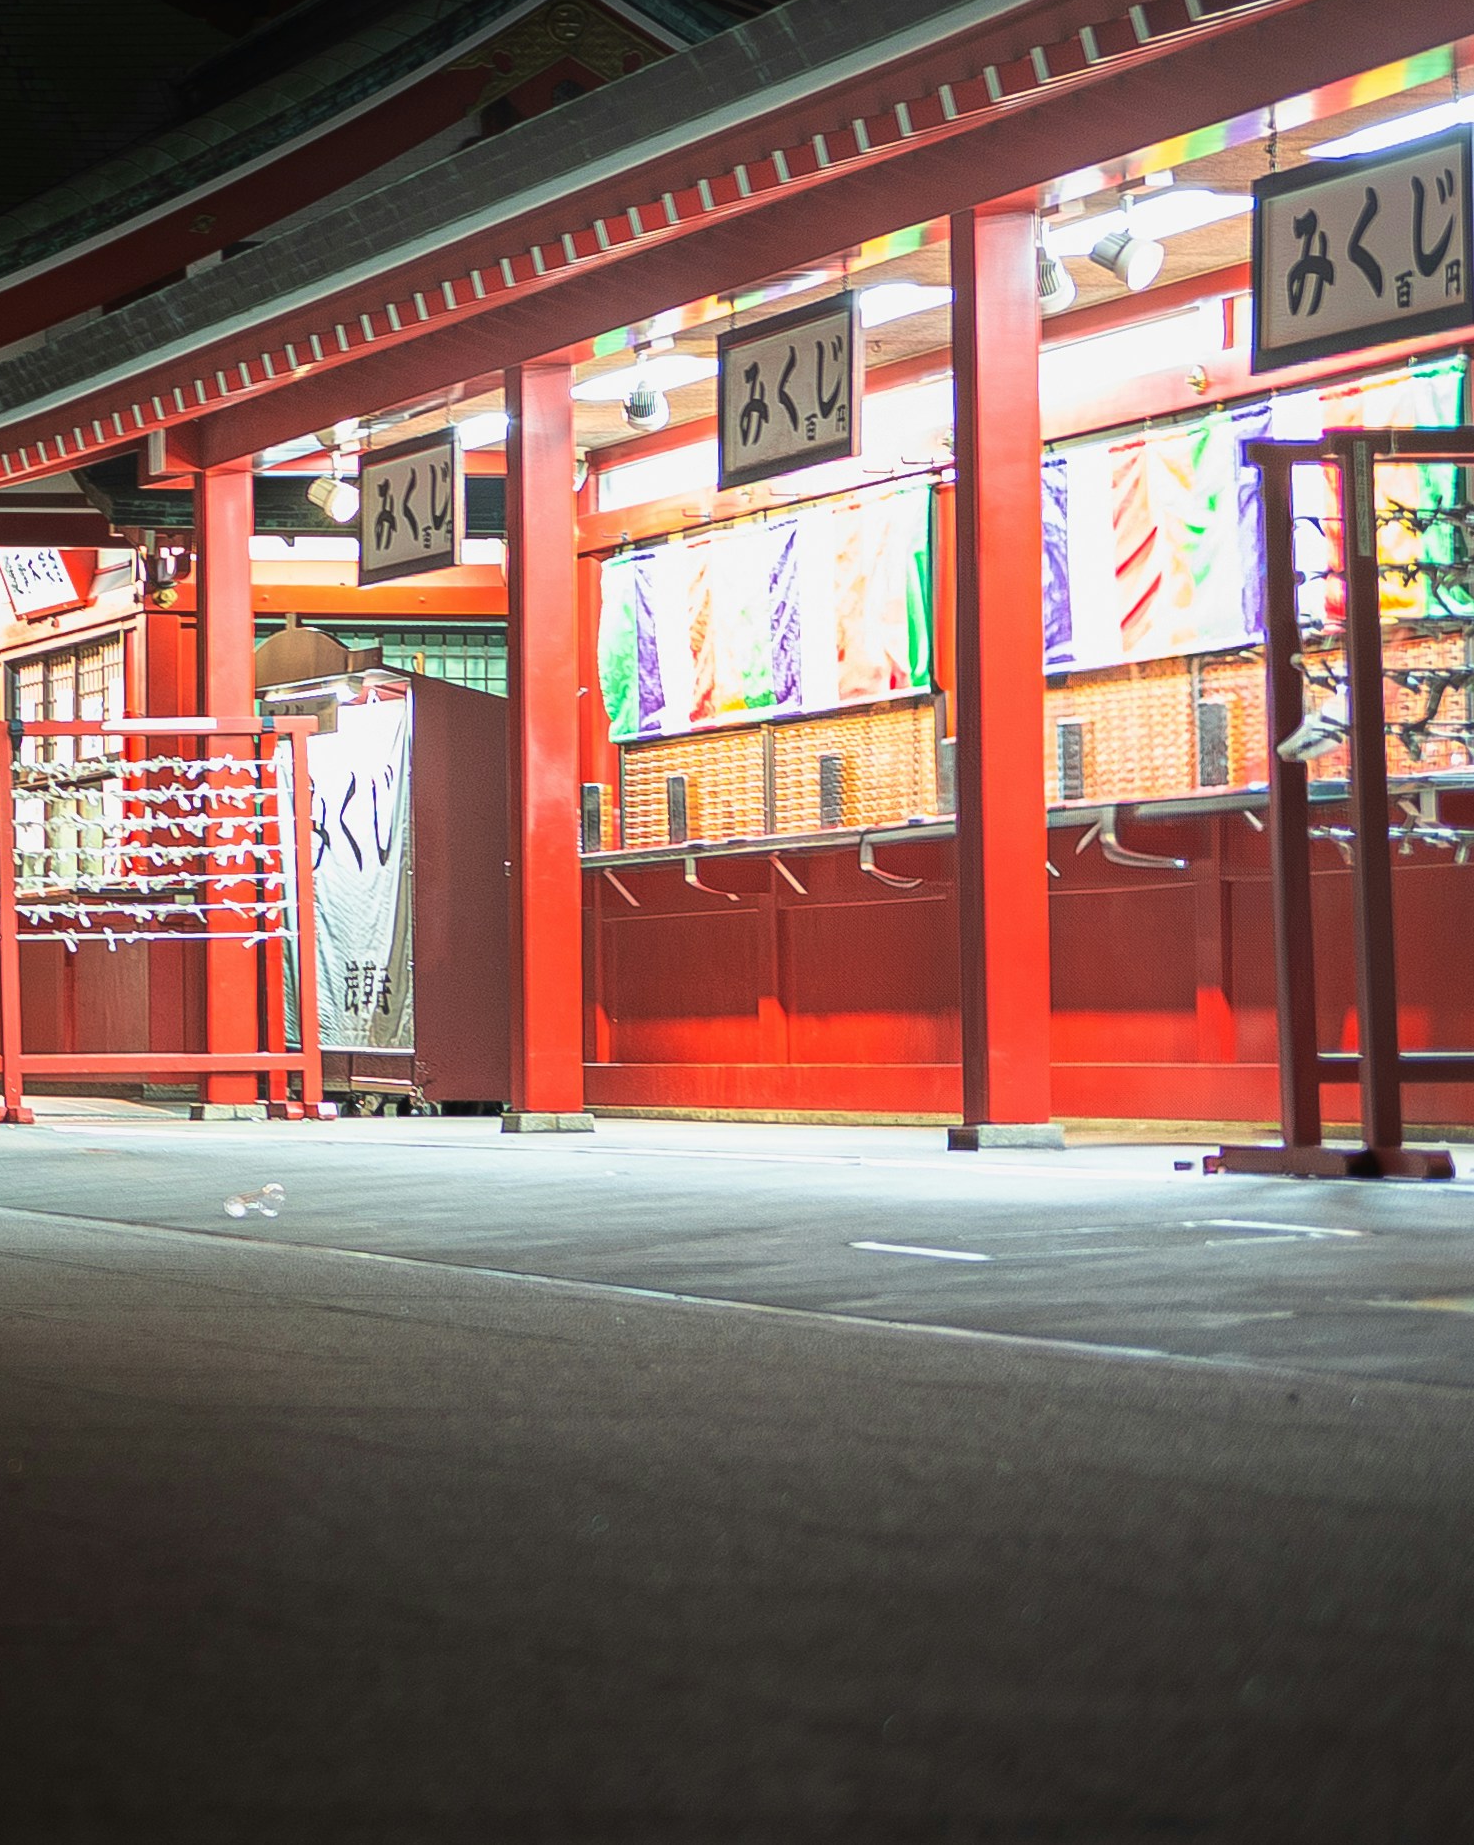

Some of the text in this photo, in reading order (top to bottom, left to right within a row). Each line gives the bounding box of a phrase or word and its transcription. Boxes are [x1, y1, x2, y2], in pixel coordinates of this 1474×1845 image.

[1287, 168, 1454, 316] みくじ
[1395, 258, 1461, 309] 百円
[739, 335, 843, 447] みくじ
[804, 404, 846, 441] 百円
[374, 461, 450, 551] みくじ
